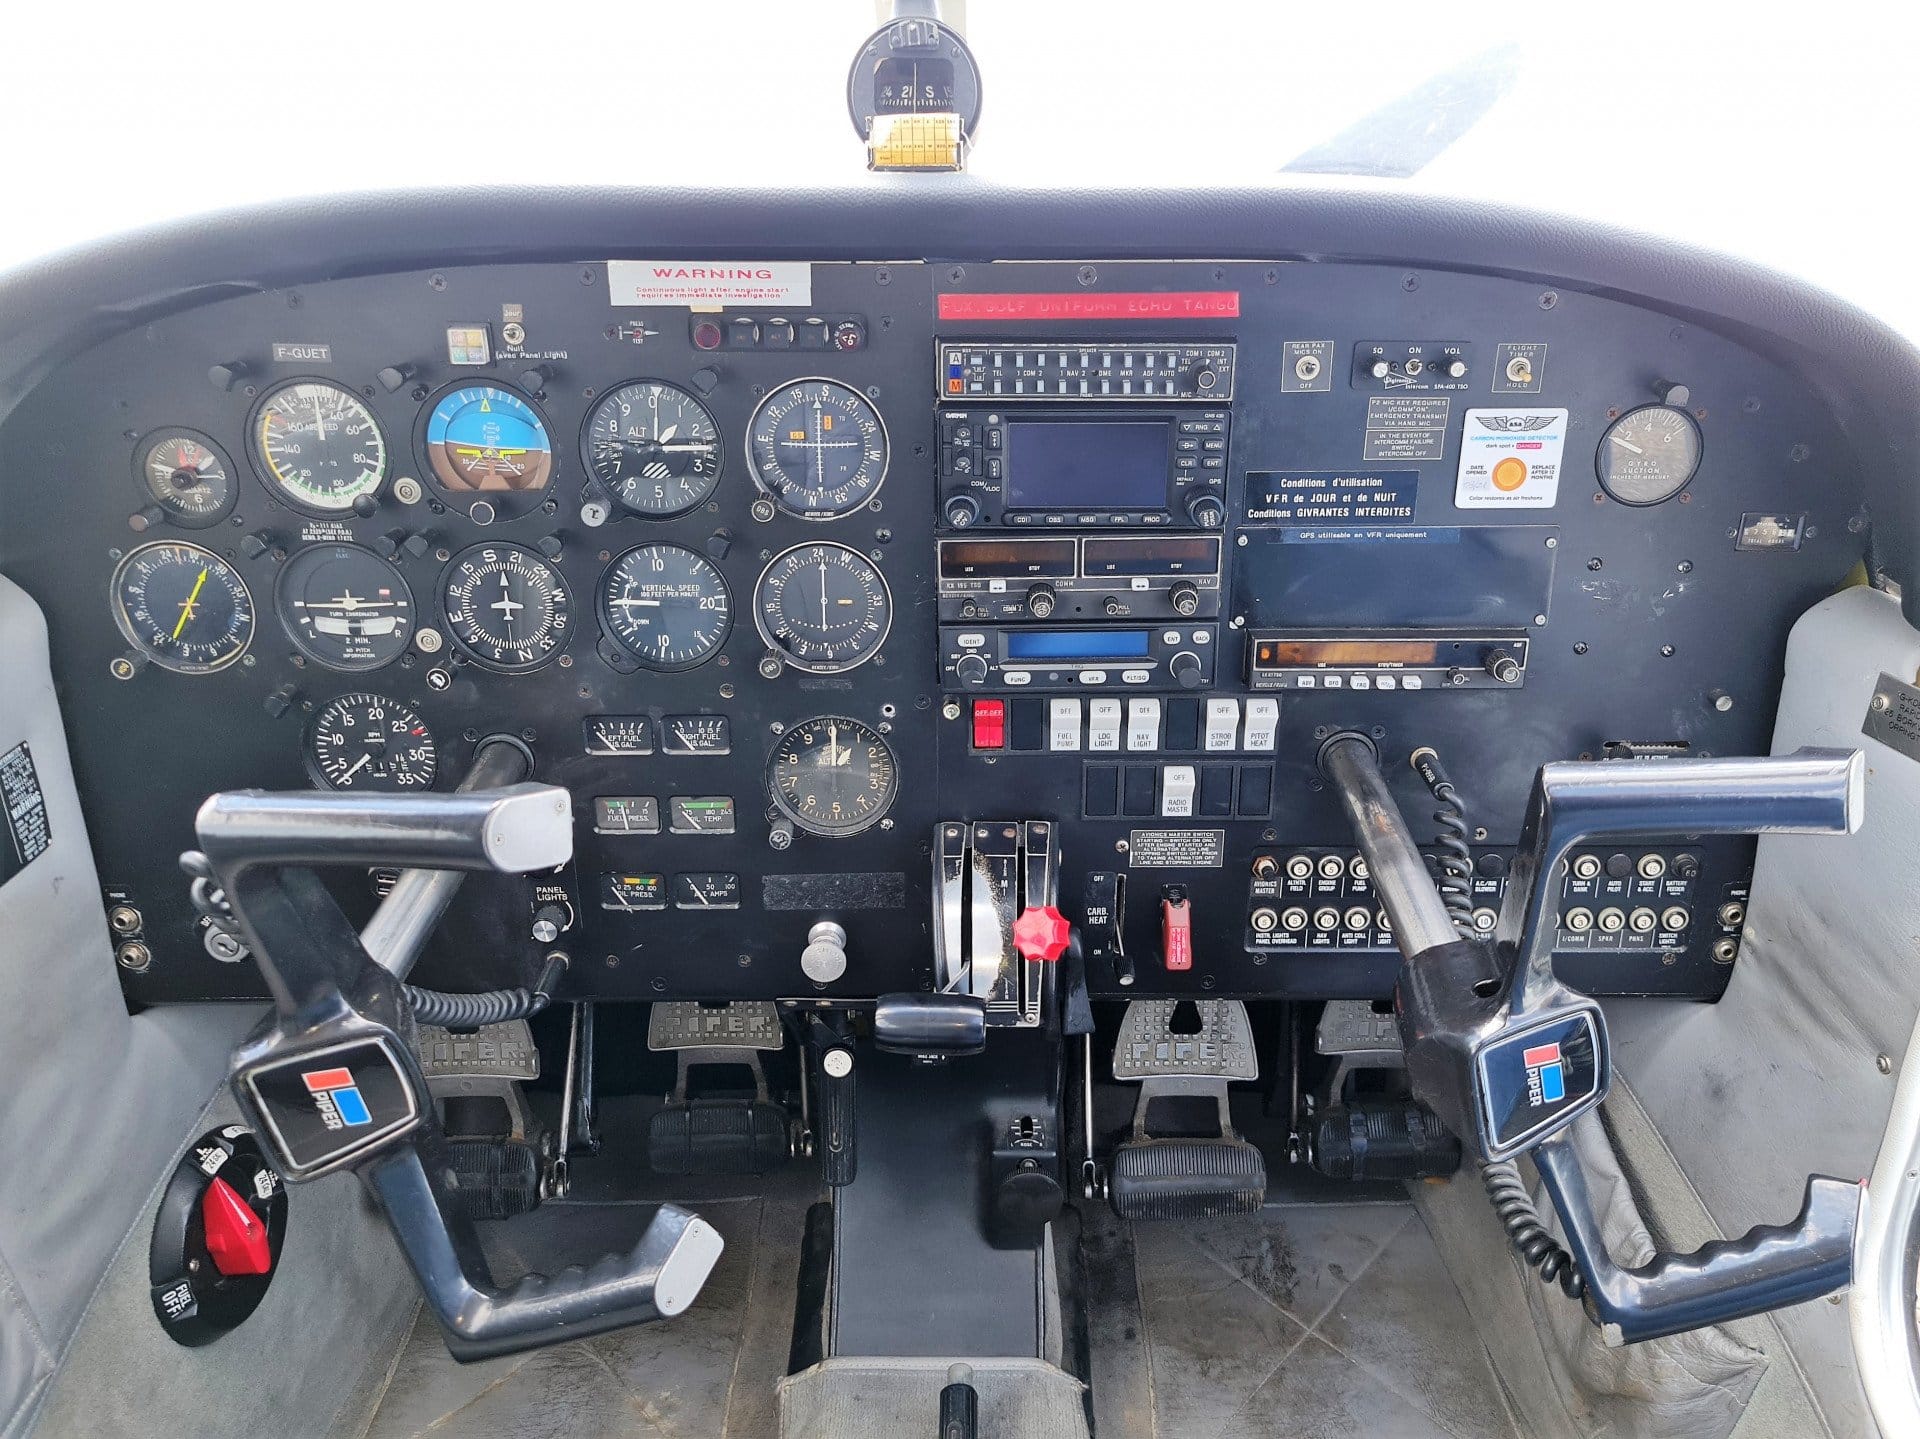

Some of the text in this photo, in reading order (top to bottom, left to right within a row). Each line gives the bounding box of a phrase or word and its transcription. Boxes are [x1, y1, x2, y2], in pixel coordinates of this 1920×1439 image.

[901, 86, 912, 97] 21
[653, 269, 772, 279] WARNING
[1184, 299, 1236, 311] TANGO
[278, 349, 327, 359] F-GUET
[628, 427, 646, 437] ALT
[1664, 434, 1671, 442] 6
[1281, 478, 1382, 488] Conditions d'utilisation
[1266, 493, 1397, 503] VFR de JOUR et de NUIT
[756, 506, 769, 515] OBS
[1248, 508, 1410, 518] Conditions GIVRANTES INTERDITES
[699, 597, 715, 609] 20
[368, 708, 384, 719] 20
[343, 715, 355, 726] 15
[392, 721, 407, 731] 25
[332, 734, 343, 745] 10
[409, 750, 425, 760] 30
[339, 758, 347, 769] 5
[397, 773, 413, 784] 35
[1089, 916, 1107, 924] HEAT
[1526, 1068, 1541, 1106] PIPER
[310, 1091, 343, 1131] PIPER
[176, 1283, 192, 1308] FUEL
[161, 1291, 182, 1317] OFF
